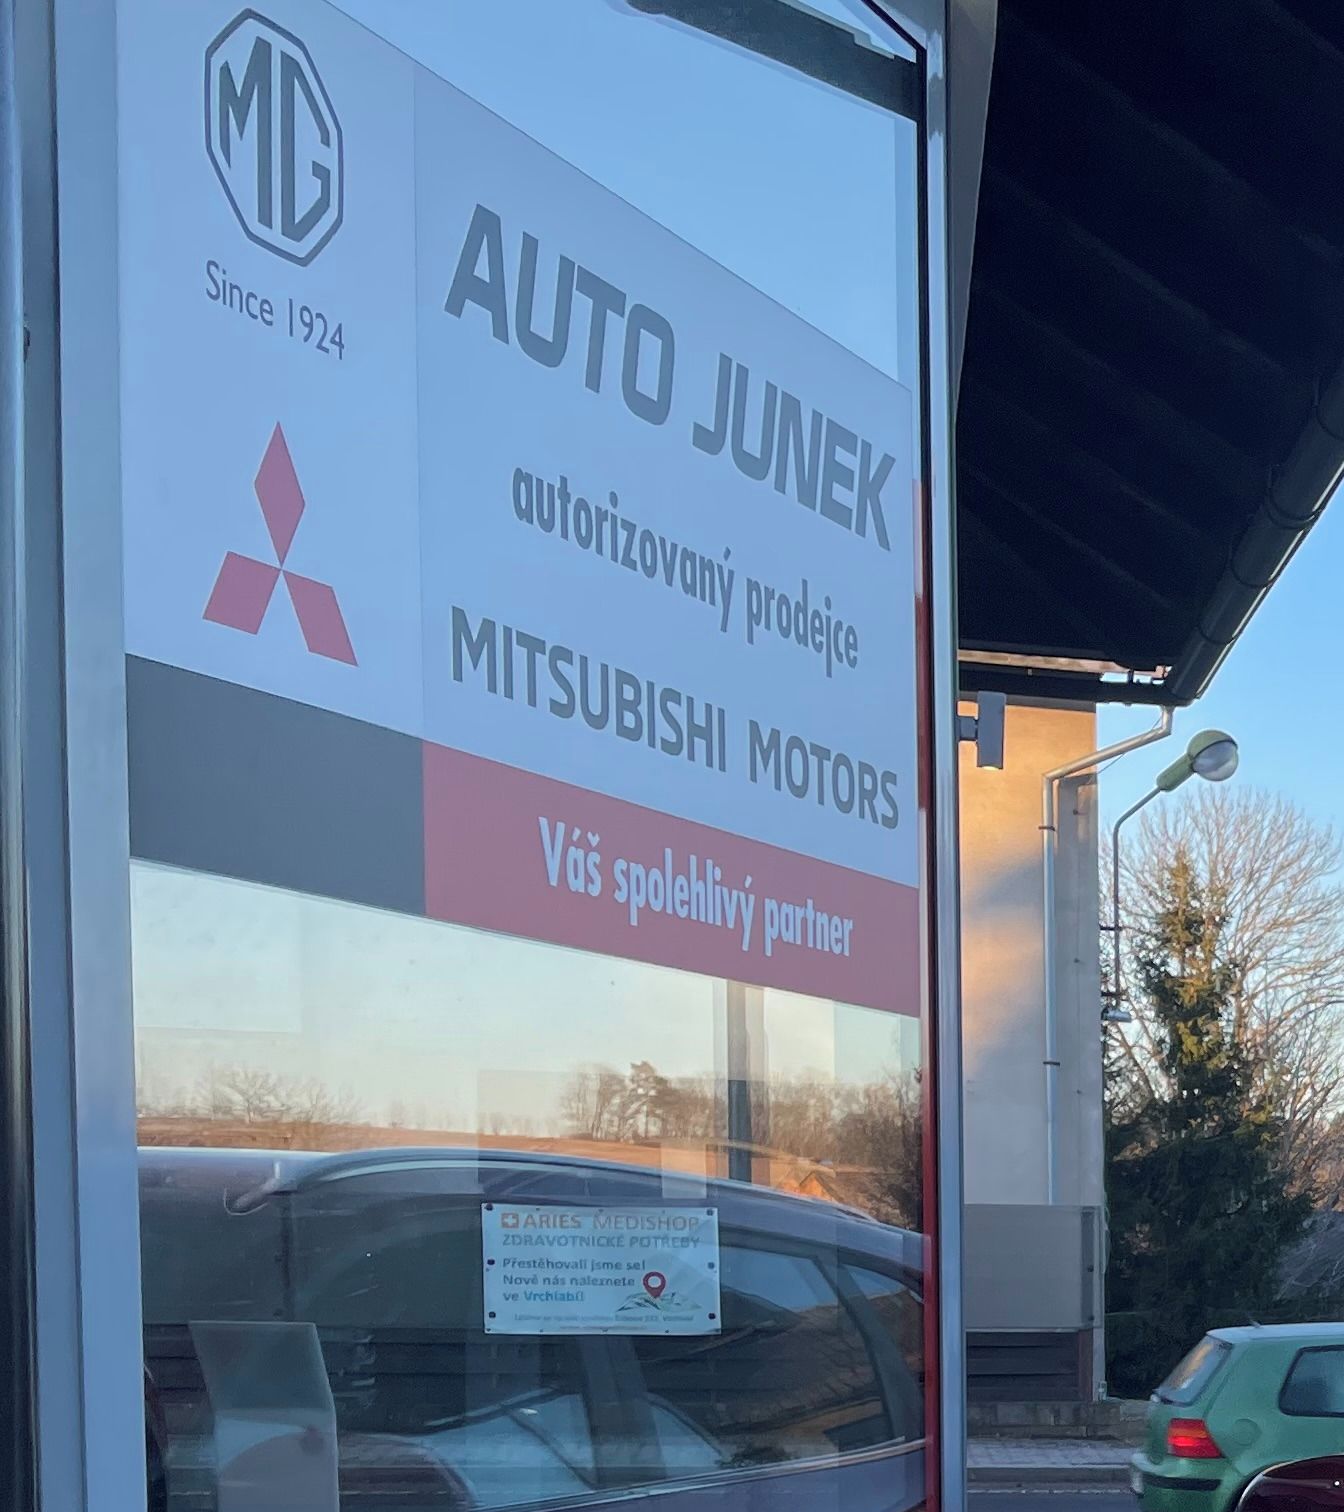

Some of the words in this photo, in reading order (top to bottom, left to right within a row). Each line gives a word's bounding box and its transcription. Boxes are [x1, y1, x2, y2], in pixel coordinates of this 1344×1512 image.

[218, 34, 332, 244] MG
[206, 260, 274, 327] Since
[289, 298, 345, 360] 1924
[444, 203, 675, 426] AUTO
[692, 352, 896, 552] JUNEK
[512, 467, 734, 633] autorizovaný
[746, 577, 858, 678] prodejce
[451, 606, 727, 773] MITSUBISHI
[748, 719, 900, 830] MOTORS
[538, 816, 602, 897] Váš
[613, 847, 755, 952] spolehlivý
[764, 895, 854, 957] partner
[523, 1214, 581, 1229] ARIES
[593, 1214, 699, 1231] MEDISHOP
[543, 1275, 566, 1286] nás
[590, 1259, 623, 1272] jsme
[503, 1293, 519, 1302] ve
